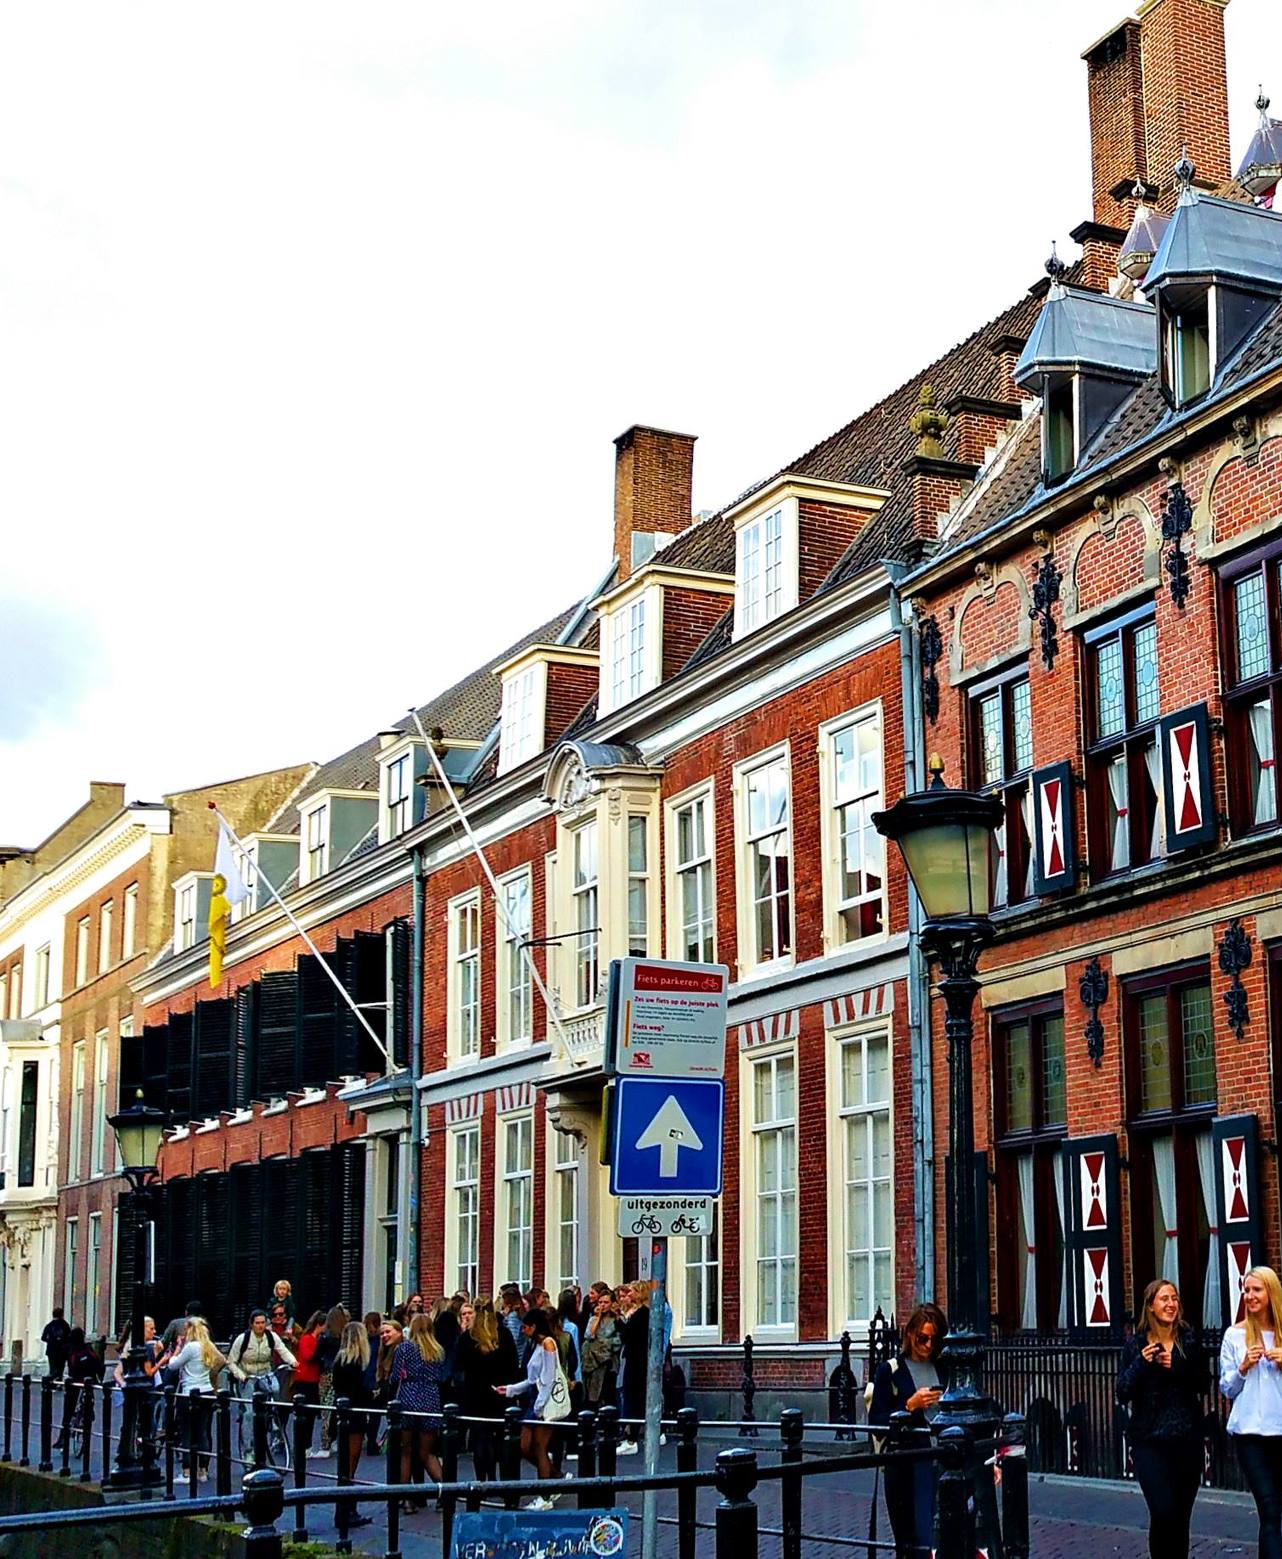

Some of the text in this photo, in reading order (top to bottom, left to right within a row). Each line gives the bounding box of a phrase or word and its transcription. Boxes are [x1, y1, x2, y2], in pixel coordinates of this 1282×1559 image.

[637, 974, 699, 987] Fiets parkeren
[627, 1199, 707, 1212] uitgezonderd
